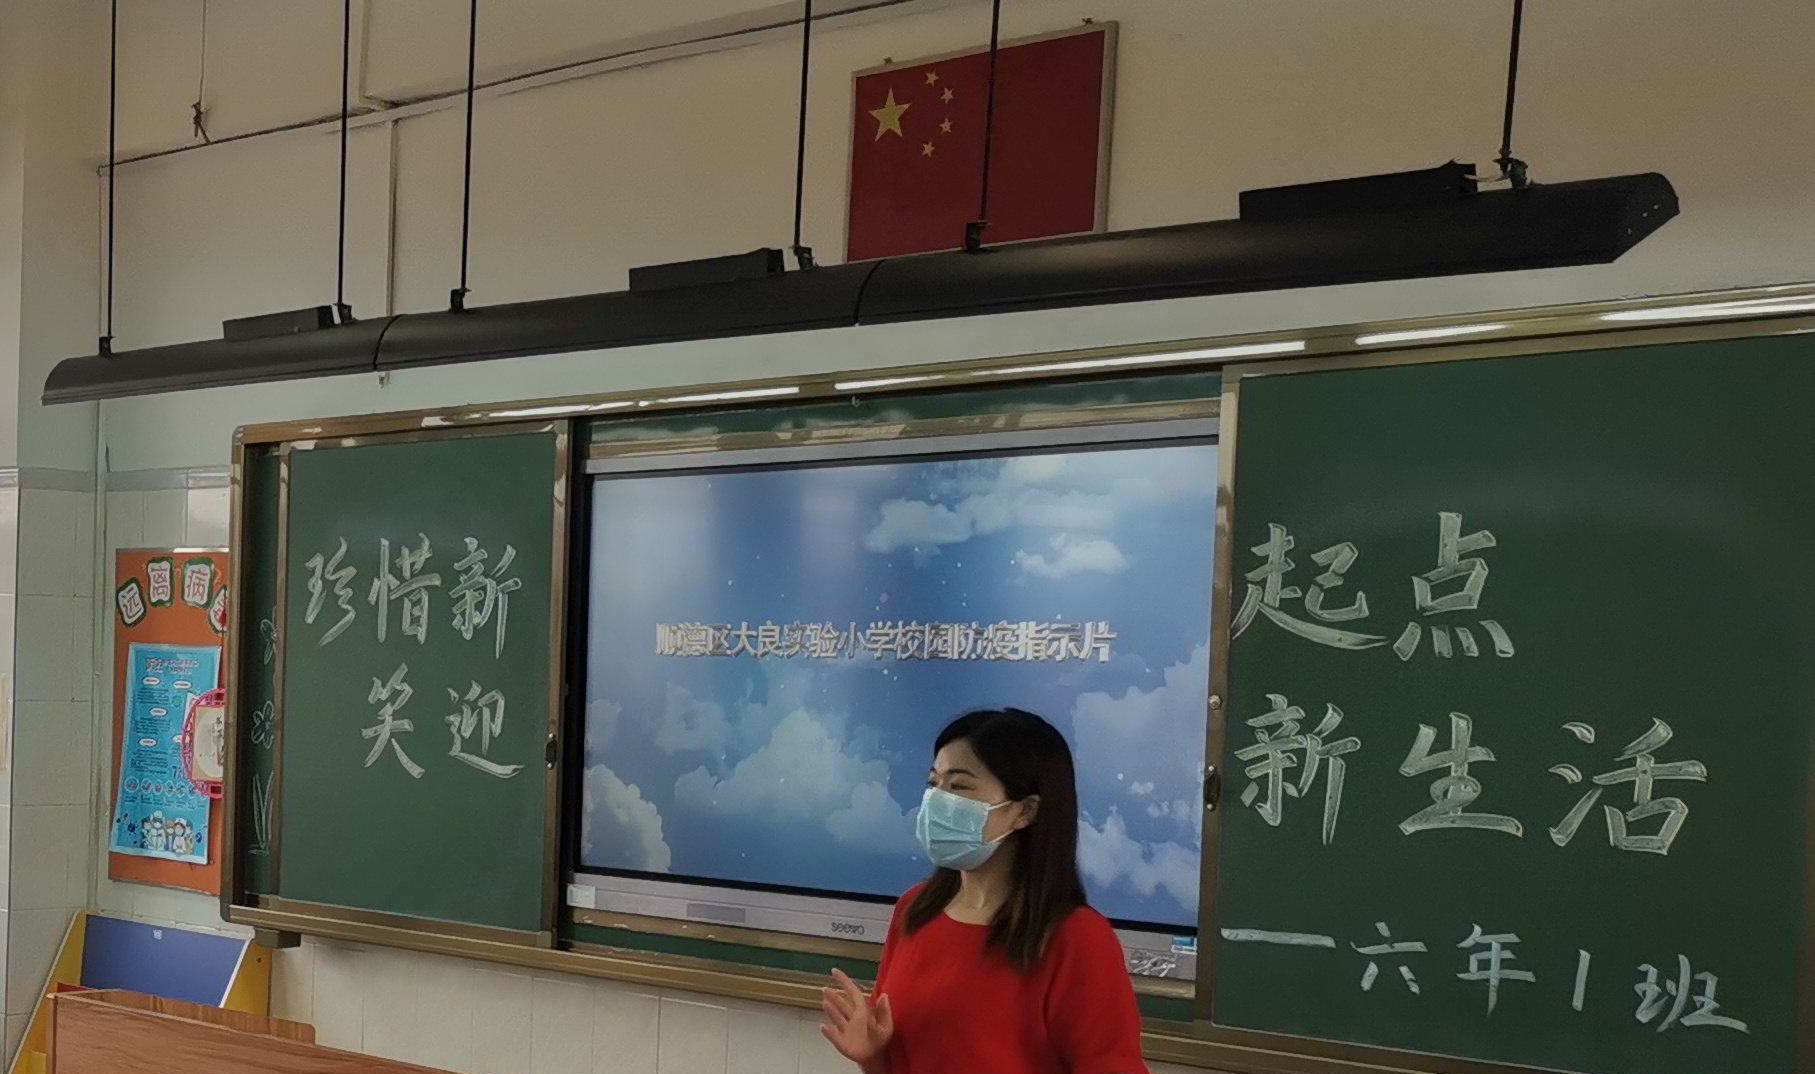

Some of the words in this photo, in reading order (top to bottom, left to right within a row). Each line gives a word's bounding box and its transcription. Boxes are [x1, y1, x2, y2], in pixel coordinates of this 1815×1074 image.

[304, 533, 523, 660] 珍惜新
[1230, 511, 1515, 661] 起点
[361, 663, 525, 779] 笑迎
[1234, 694, 1708, 855] 新生活
